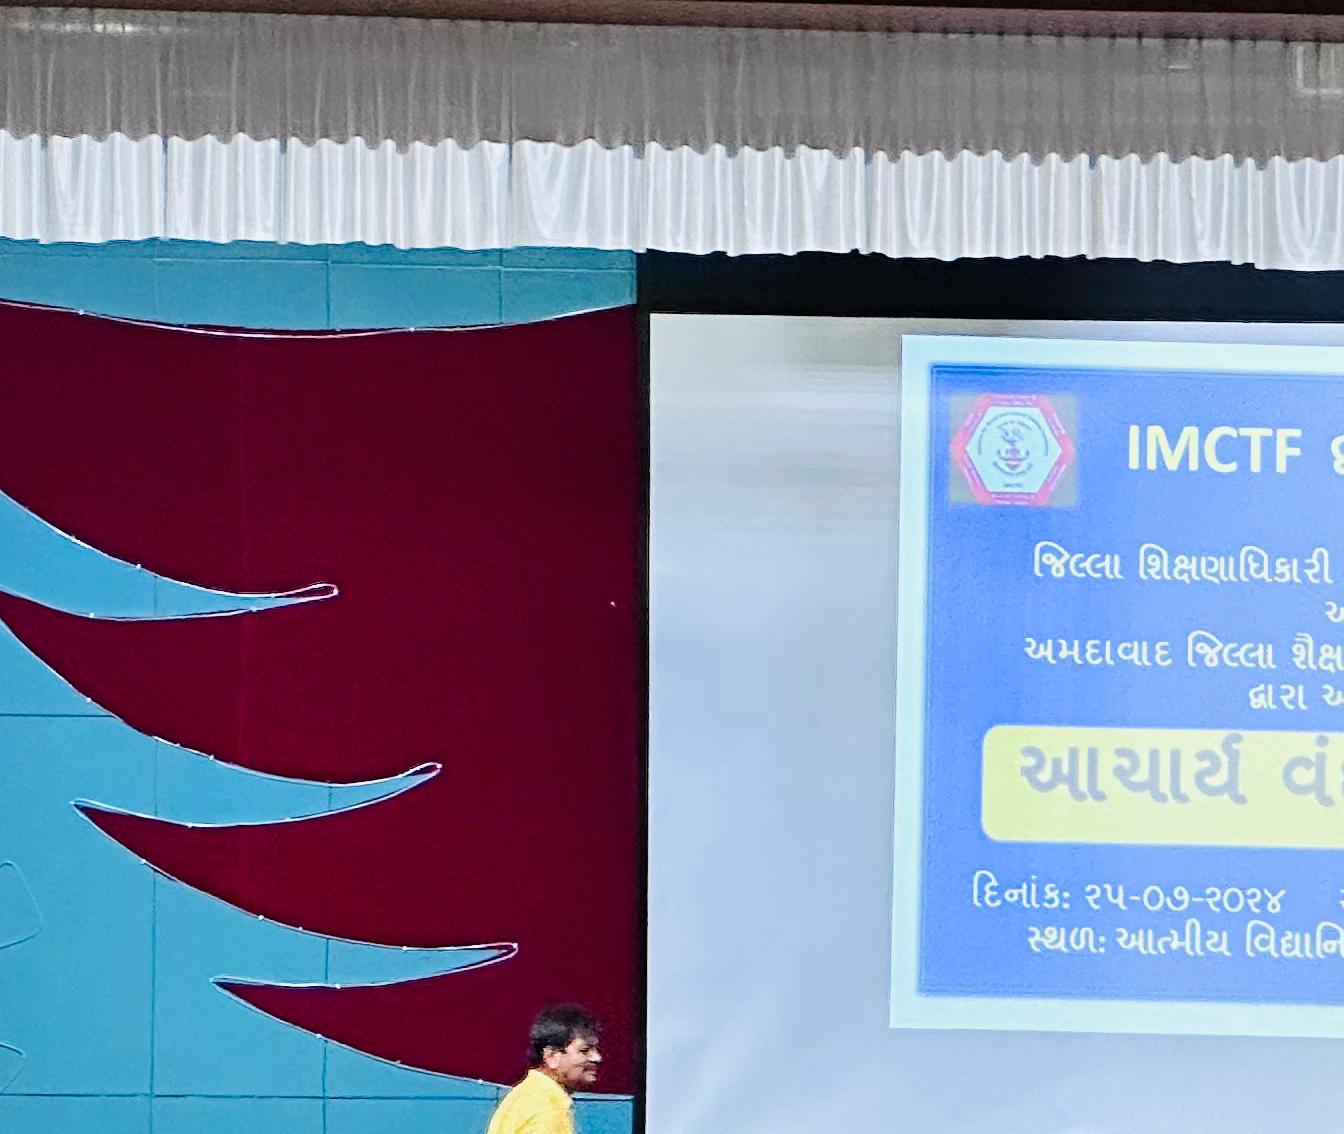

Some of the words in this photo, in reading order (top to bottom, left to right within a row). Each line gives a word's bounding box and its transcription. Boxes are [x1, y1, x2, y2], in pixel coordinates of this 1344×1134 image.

[1128, 425, 1302, 473] IMCTF
[1034, 541, 1124, 579] જિલ્લા
[1139, 544, 1333, 584] શિક્ષણાધિકારી
[1024, 638, 1172, 666] અમદાવાદ
[1188, 630, 1276, 668] જિલ્લા
[1249, 684, 1307, 709] દ્વારા
[1018, 733, 1248, 806] આચાર્ય
[973, 870, 1070, 909] દિનાંક:
[1028, 927, 1106, 953] સ્થળ:
[1116, 918, 1232, 956] આત્મીય
